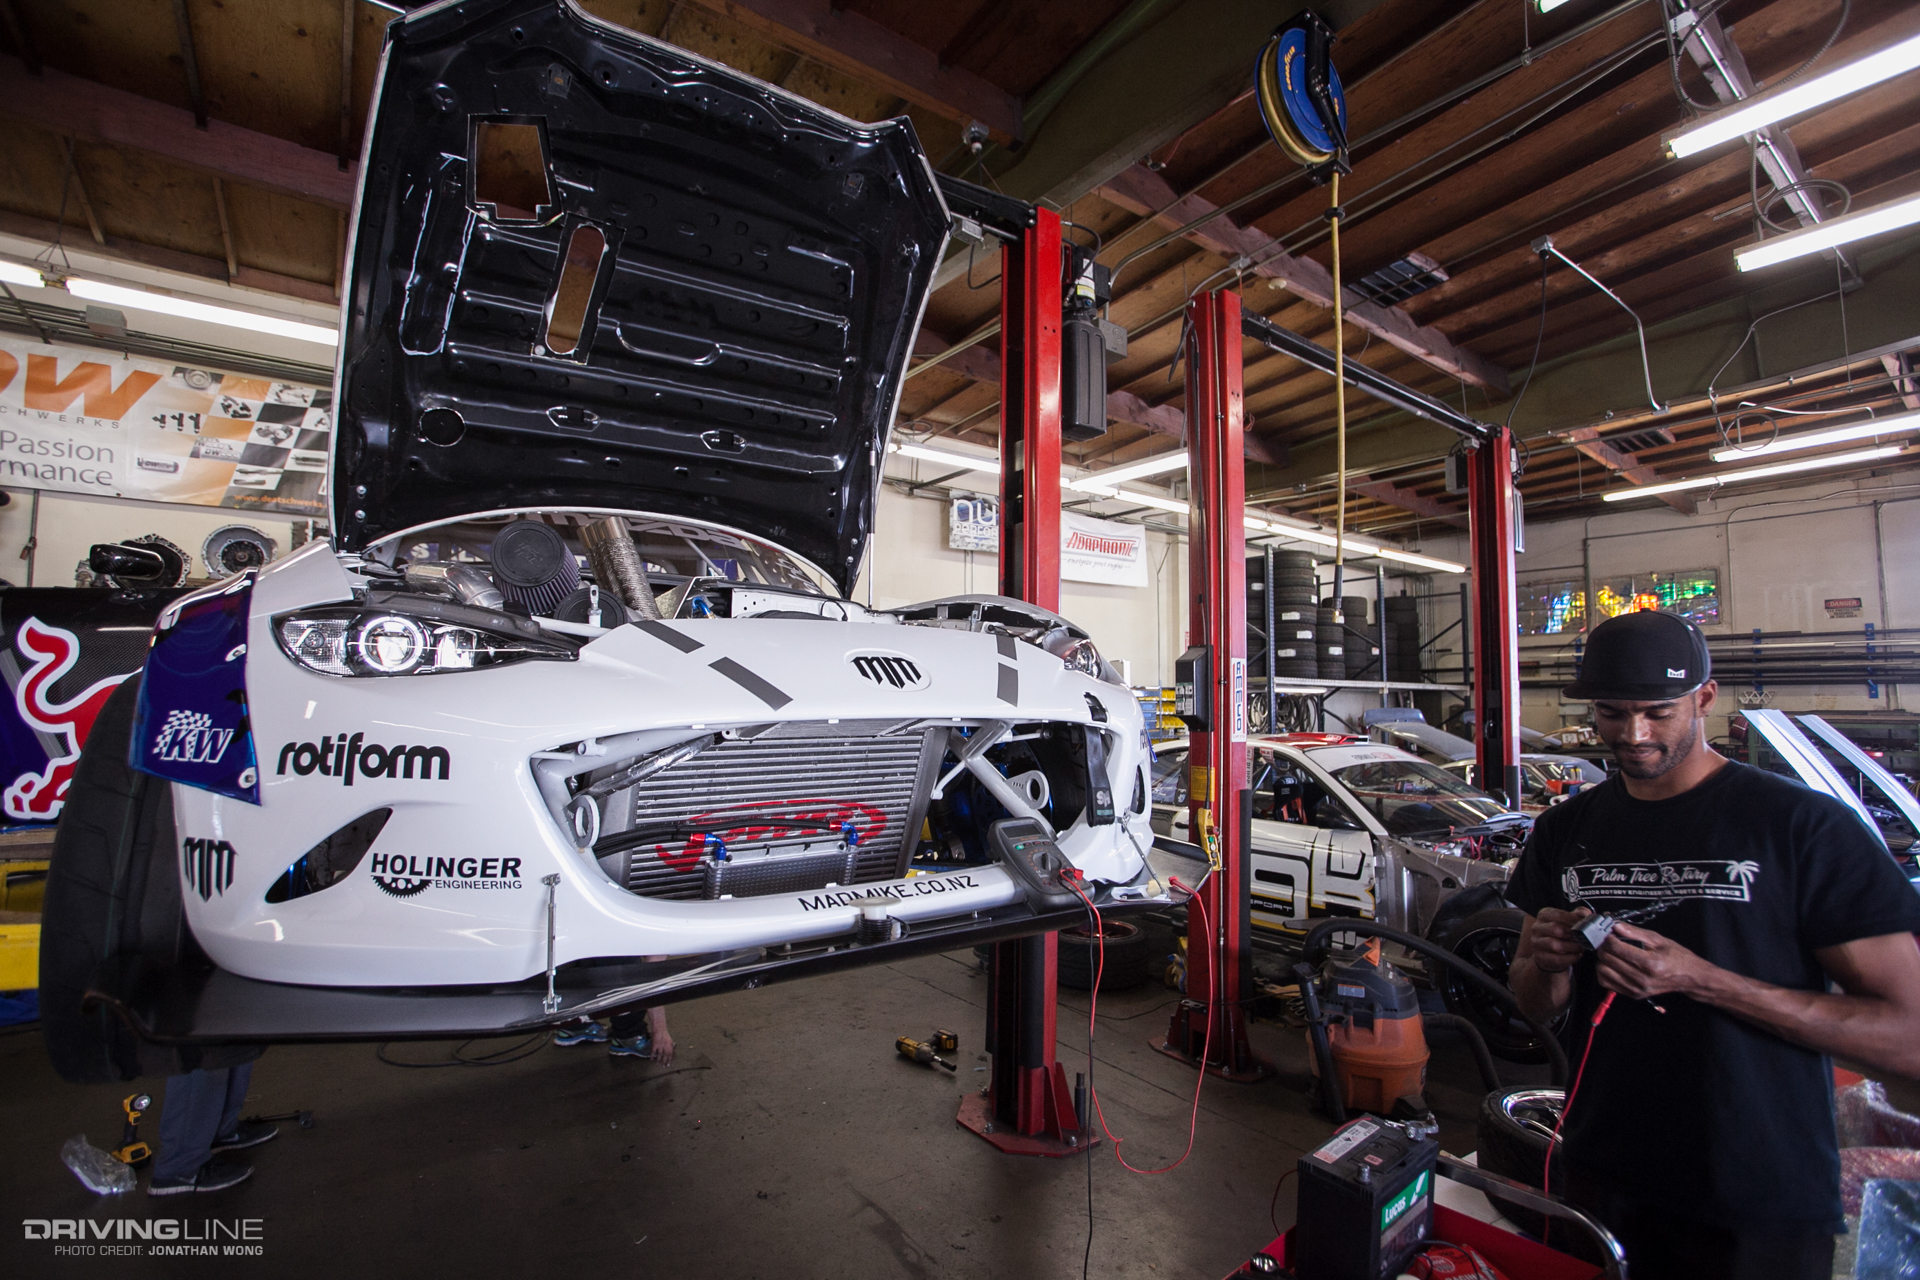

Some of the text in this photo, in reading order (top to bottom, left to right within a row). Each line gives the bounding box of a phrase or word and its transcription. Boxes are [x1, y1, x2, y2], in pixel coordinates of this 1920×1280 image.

[0, 429, 114, 464] Passion
[1235, 661, 1243, 731] AMMCO
[160, 727, 235, 763] KW
[276, 731, 451, 786] rotiform
[371, 853, 522, 878] HOLINGER
[1591, 865, 1710, 887] Palm Tree Rotary
[435, 879, 523, 890] ENGINEERING
[1705, 888, 1741, 896] SERVICE
